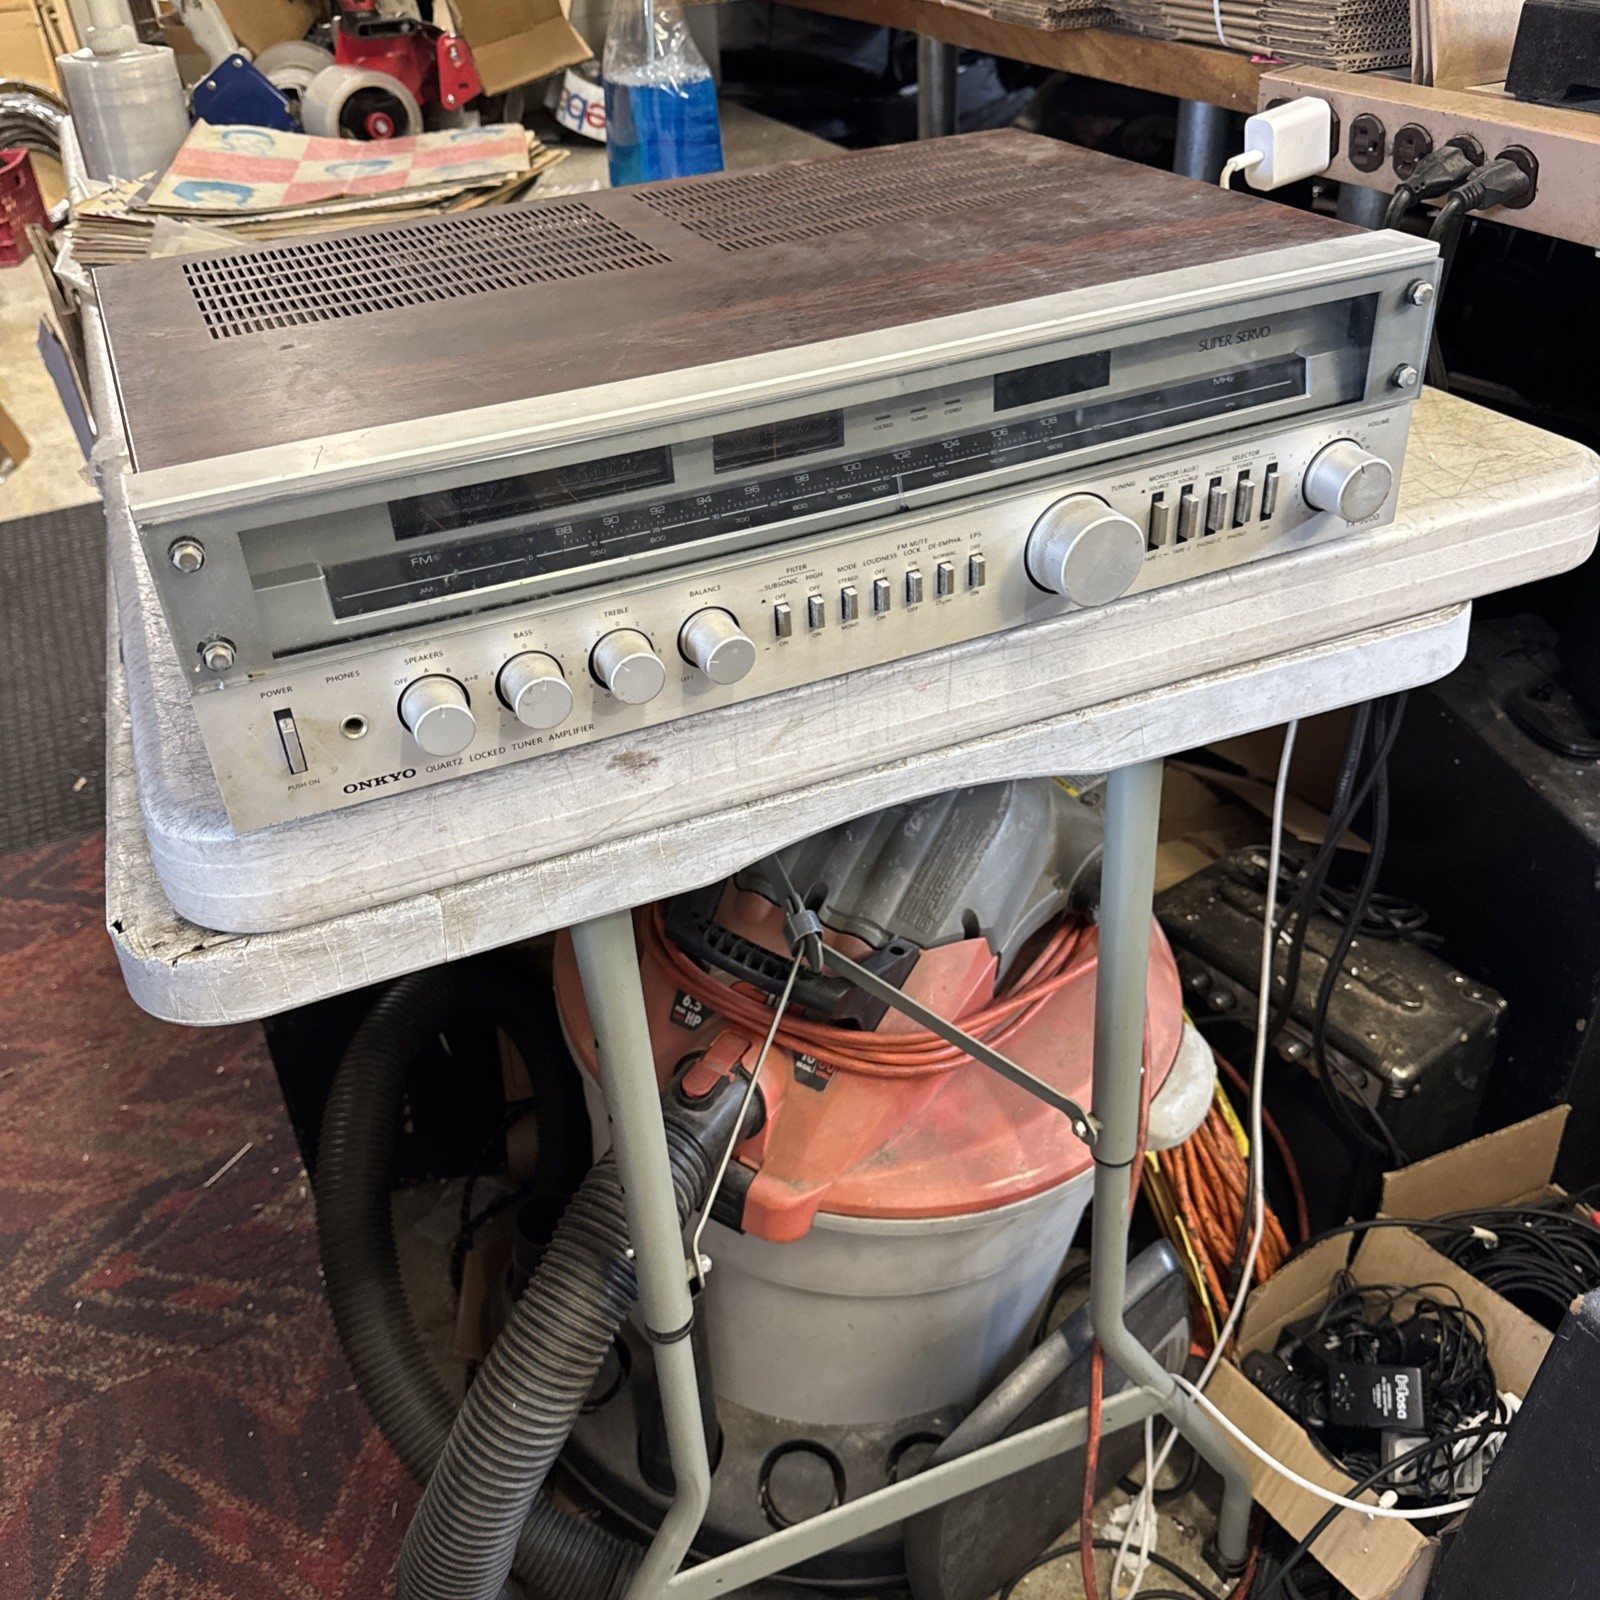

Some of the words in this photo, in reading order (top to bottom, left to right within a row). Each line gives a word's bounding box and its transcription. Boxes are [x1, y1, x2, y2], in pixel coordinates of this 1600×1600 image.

[1198, 334, 1233, 352] SUPER
[1235, 326, 1271, 344] SERVO
[1367, 418, 1391, 428] VOLUME
[1231, 449, 1260, 462] SELECTOR
[410, 554, 433, 567] FM
[555, 525, 573, 536] 88
[602, 515, 620, 526] 90
[649, 505, 666, 516] 92
[696, 495, 712, 506] 94
[744, 484, 760, 495] 96
[794, 473, 810, 484] 98
[842, 461, 862, 472] 100
[892, 450, 912, 461] 102
[941, 439, 960, 449] 104
[990, 428, 1009, 438] 106
[1040, 416, 1058, 426] 108
[1212, 375, 1234, 386] MHz
[1236, 461, 1253, 470] TUNER
[1149, 469, 1179, 482] MONITOR
[1111, 480, 1136, 492] TUNING
[419, 586, 434, 596] AM
[589, 548, 607, 557] 550
[735, 516, 751, 524] 700
[792, 502, 808, 511] 800
[871, 484, 890, 492] 1000
[969, 531, 982, 540] EPS
[896, 542, 908, 551] FM
[909, 537, 928, 548] MUTE
[970, 543, 981, 551] OFF
[903, 547, 921, 557] LOCK
[932, 550, 956, 560] NORMAL
[862, 552, 898, 567] LOUDNESS
[786, 563, 808, 574] FILTER
[837, 562, 857, 573] MODE
[874, 568, 886, 576] OFF
[805, 571, 824, 580] HIGH
[838, 575, 859, 585] STEREO
[764, 577, 799, 591] SUBSONIC
[809, 584, 820, 592] OFF
[689, 584, 722, 598] BALANCE
[603, 607, 630, 618] TREBLE
[841, 621, 860, 630] MONO
[513, 629, 533, 640] BASS
[403, 650, 444, 666] SPEAKERS
[325, 669, 360, 684] PHONES
[394, 677, 409, 686] OFF
[464, 674, 479, 683] A+B
[680, 675, 694, 683] LEFT
[260, 685, 293, 699] POWER
[343, 768, 417, 794] ONKYO
[425, 757, 463, 773] QUARTZ
[469, 747, 506, 762] LOCKED
[511, 736, 543, 751] TUNER
[548, 723, 595, 741] AMPLIFIER
[287, 781, 307, 791] PUSH
[308, 778, 321, 786] ON
[684, 1011, 702, 1027] HP
[1395, 1374, 1410, 1420] Hosa
